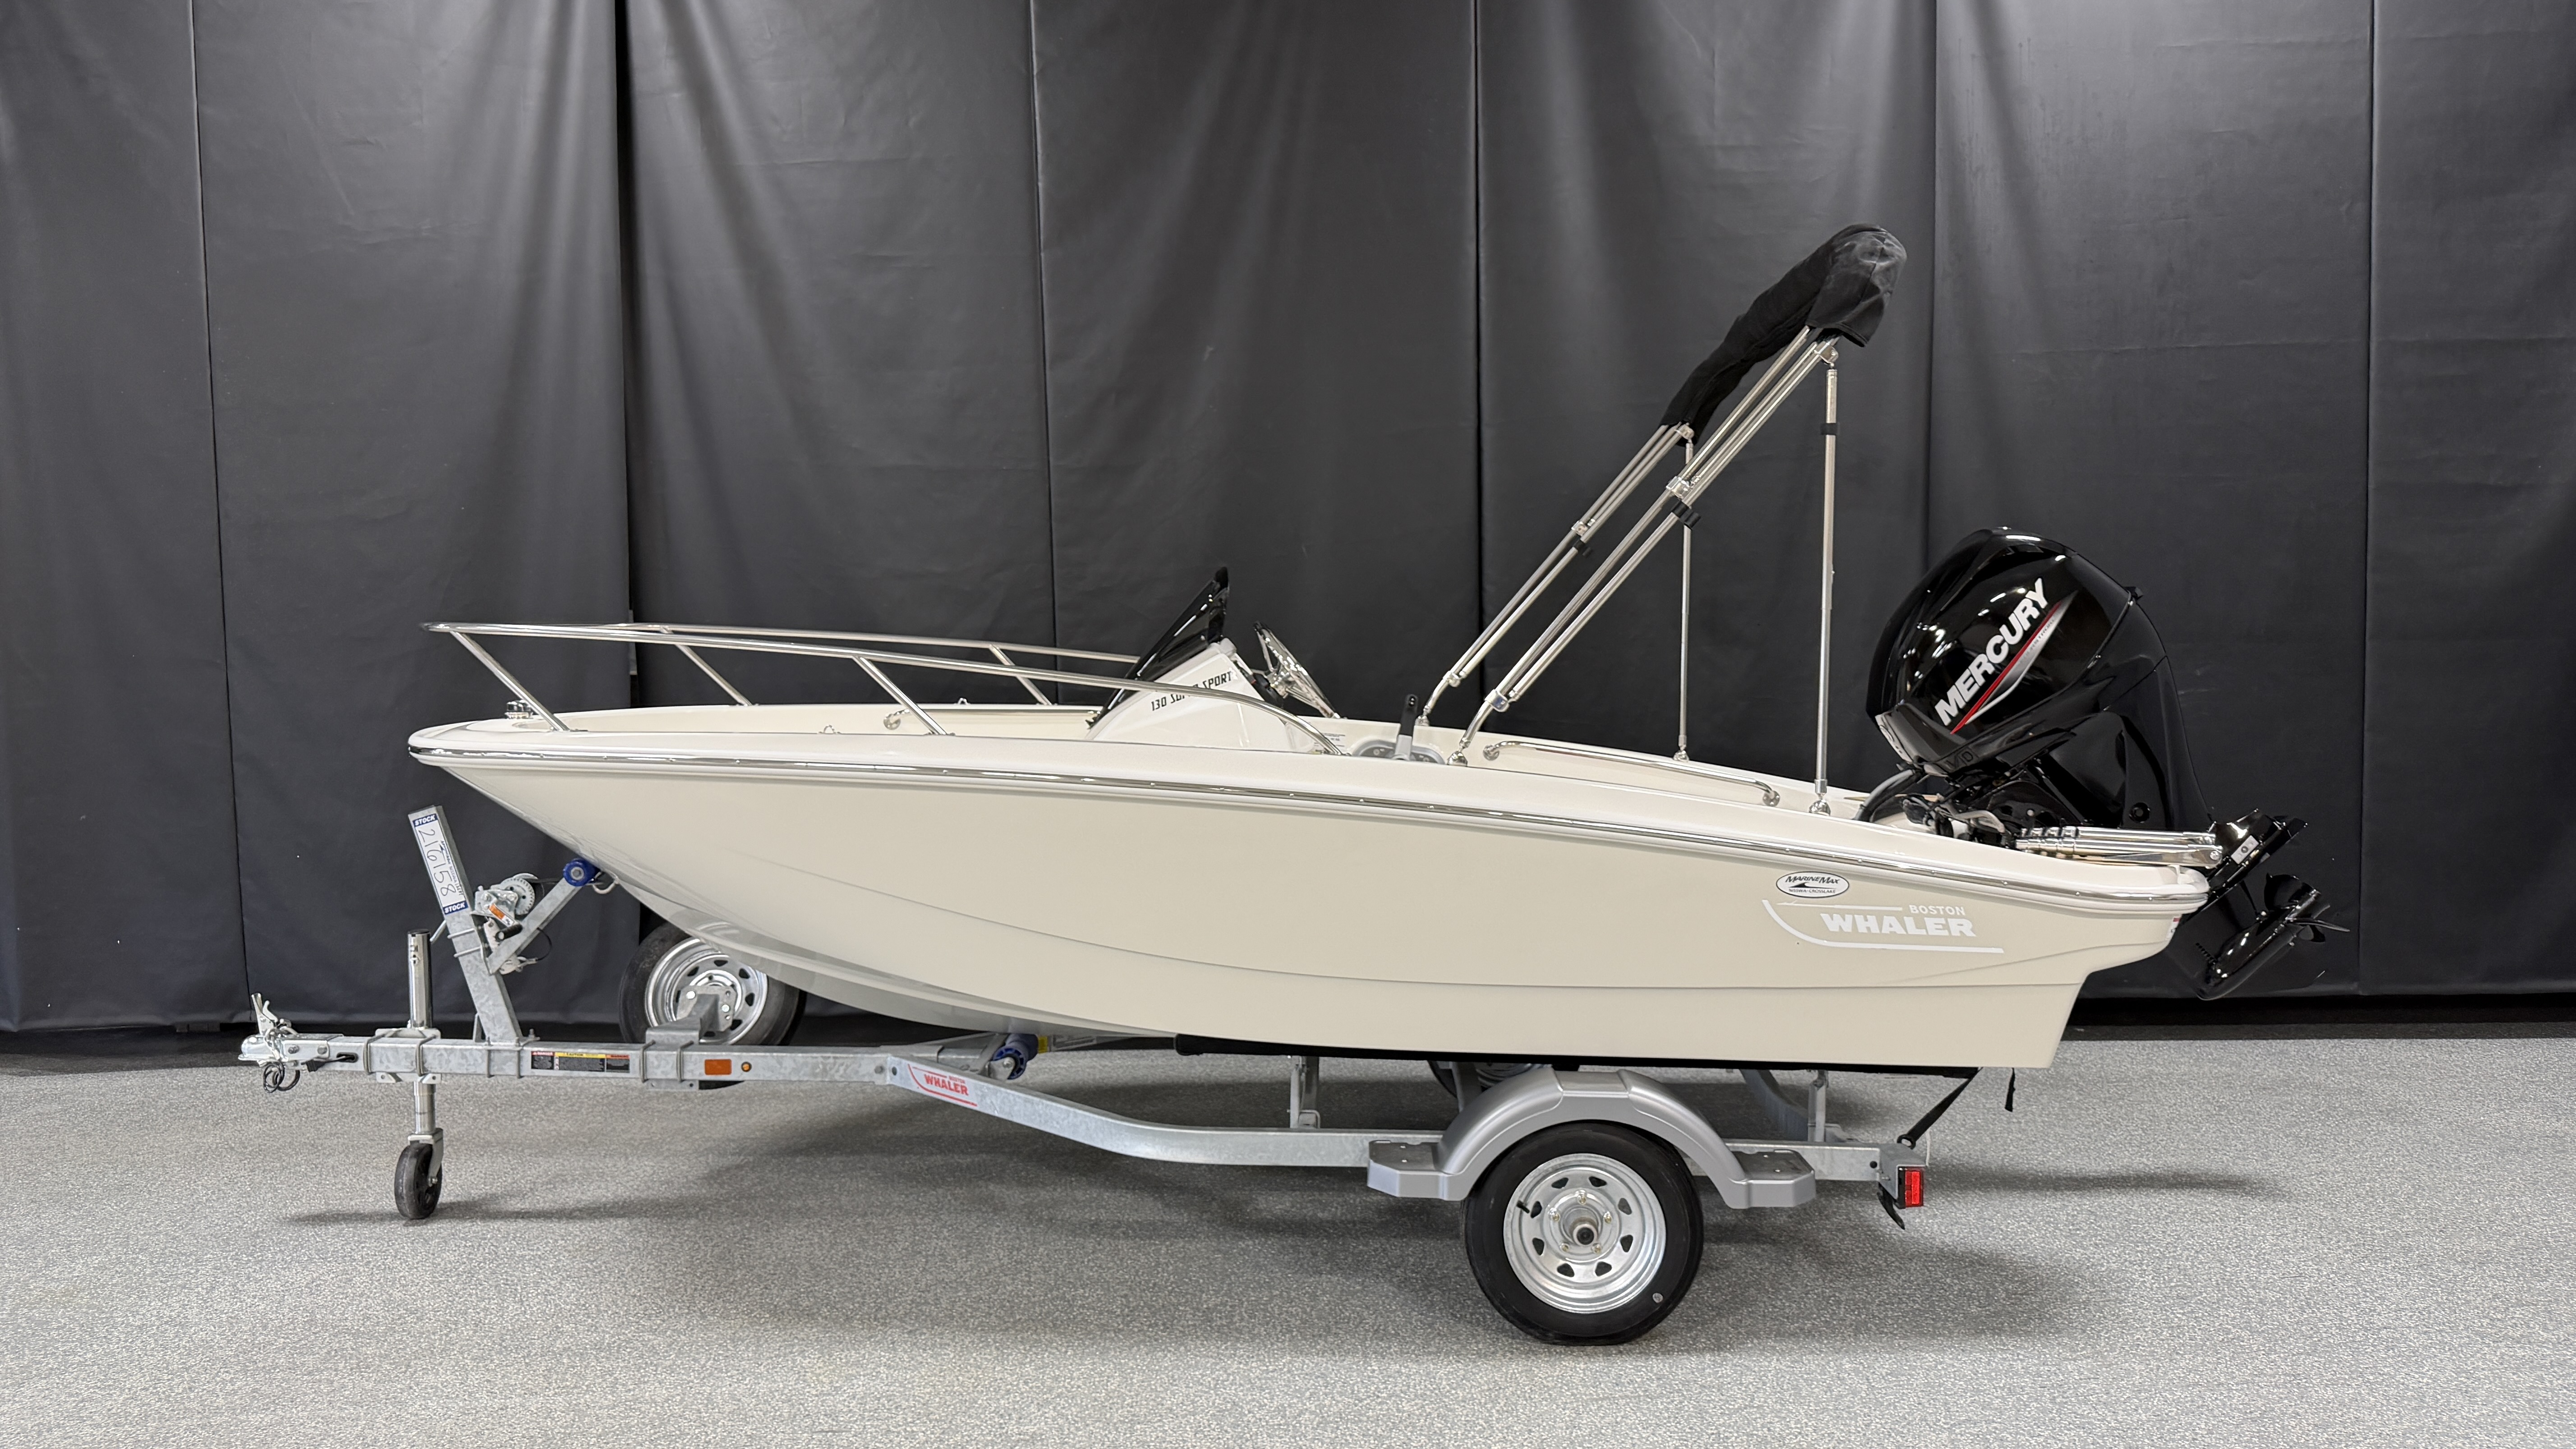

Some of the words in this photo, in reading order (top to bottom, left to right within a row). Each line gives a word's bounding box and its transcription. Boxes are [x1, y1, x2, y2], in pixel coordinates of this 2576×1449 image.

[1934, 577, 2048, 726] MERCURY
[1151, 697, 1167, 711] 130
[1203, 671, 1231, 689] SPORT
[414, 814, 436, 826] STOCK
[418, 829, 456, 897] 216158
[444, 902, 466, 914] STOCK
[1909, 905, 1965, 916] BOSTON
[1820, 913, 1977, 937] WHALER
[924, 1074, 969, 1096] WHALER
